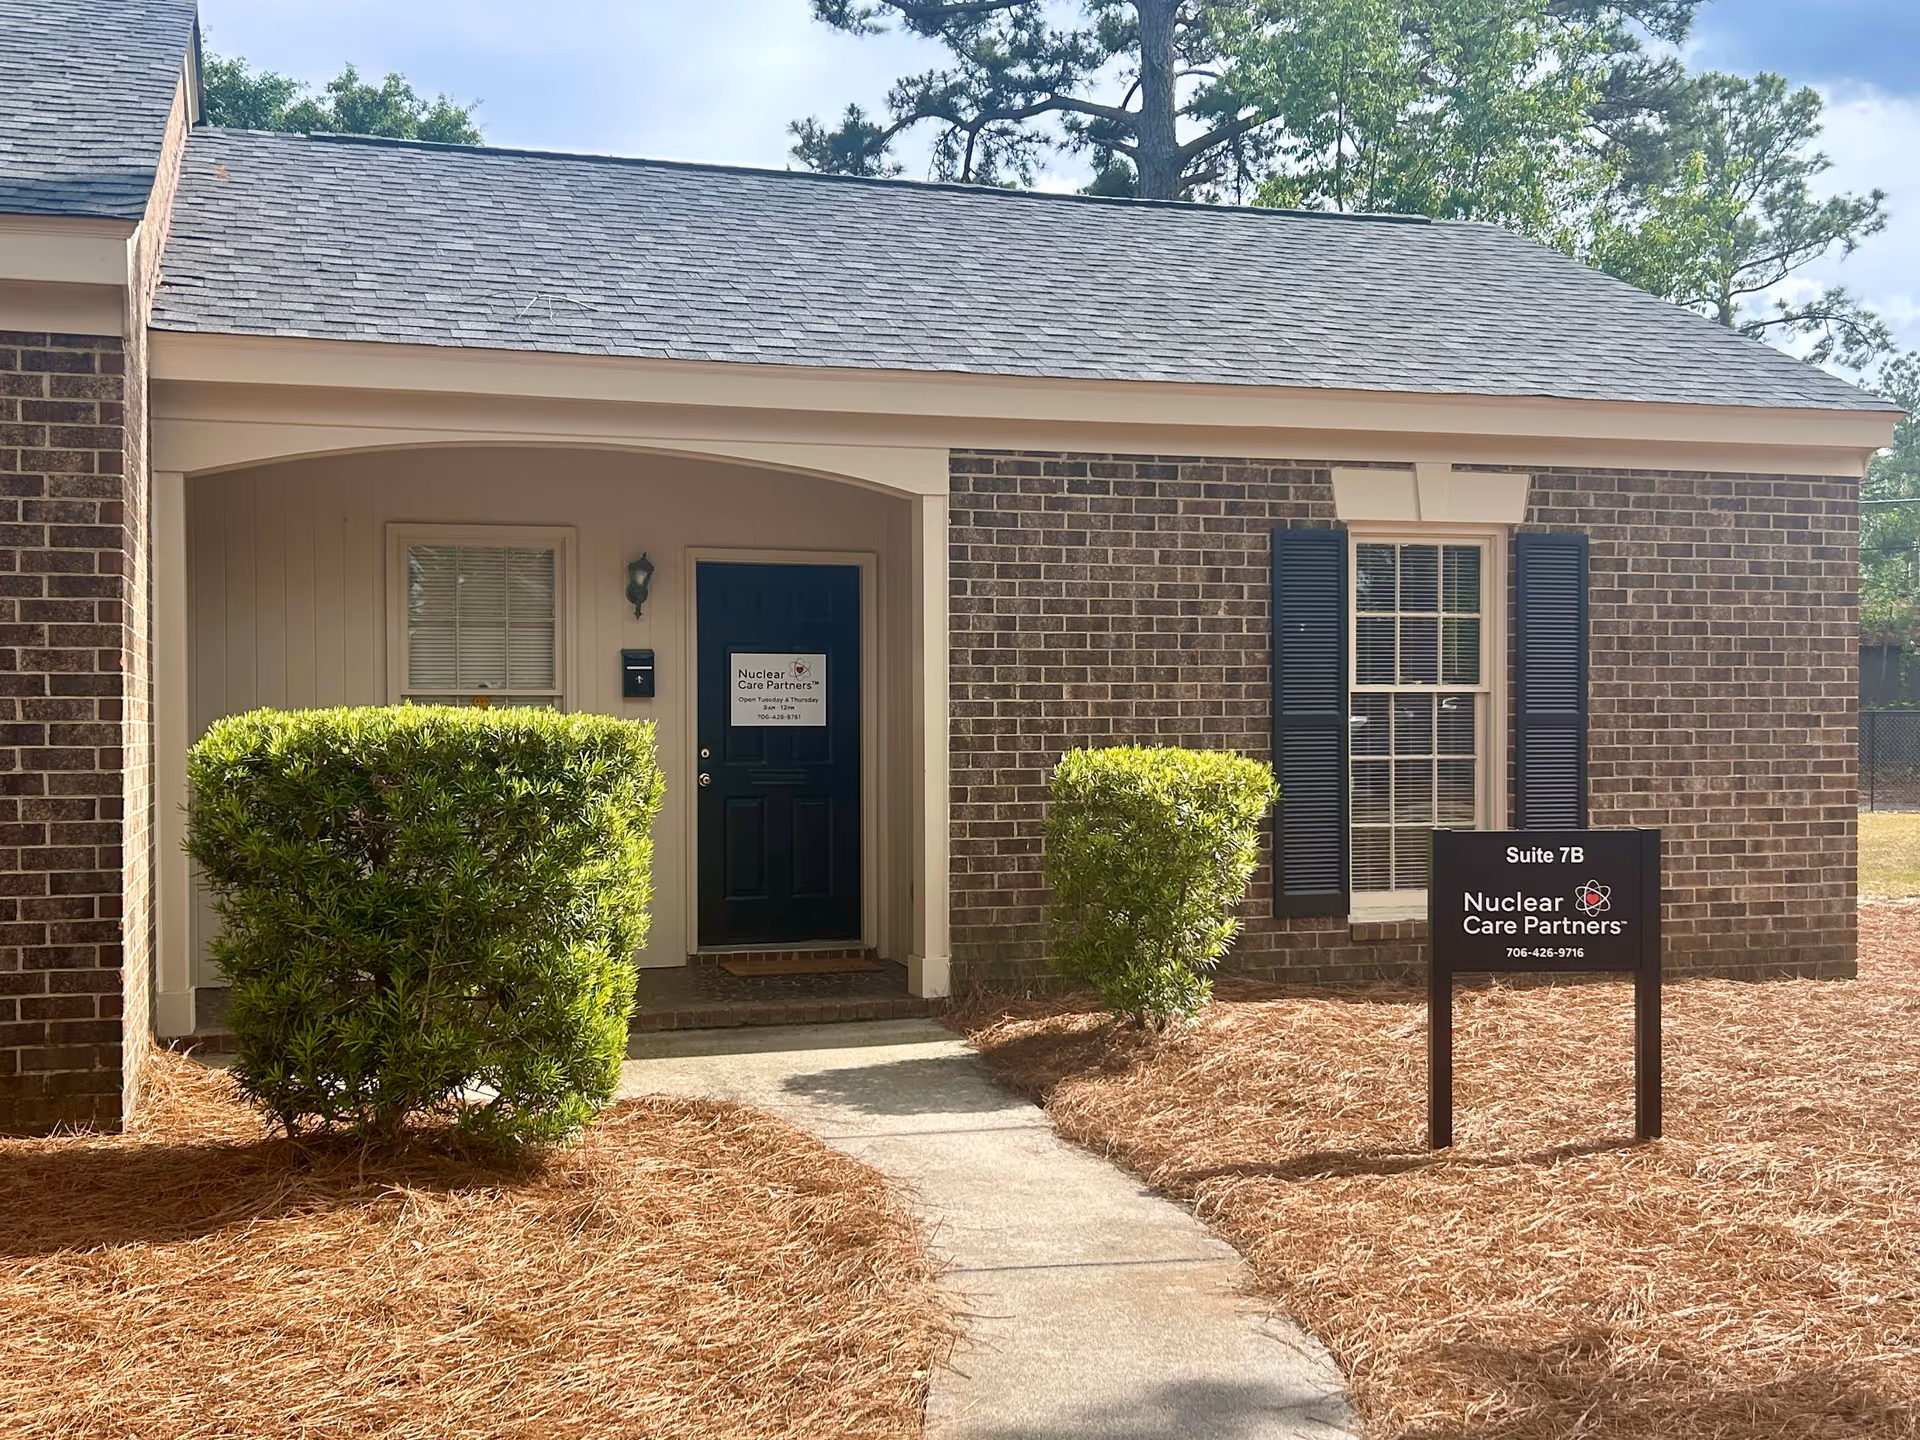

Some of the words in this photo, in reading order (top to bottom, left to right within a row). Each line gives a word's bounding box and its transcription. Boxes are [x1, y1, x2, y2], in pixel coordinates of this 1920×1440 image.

[738, 669, 785, 679] Nuclear
[738, 680, 764, 690] Care
[1506, 846, 1554, 863] Suite
[1559, 847, 1584, 863] 7B
[1464, 891, 1564, 912] Nuclear
[1463, 915, 1517, 935] Care
[1506, 947, 1585, 958] 706-426-9716
